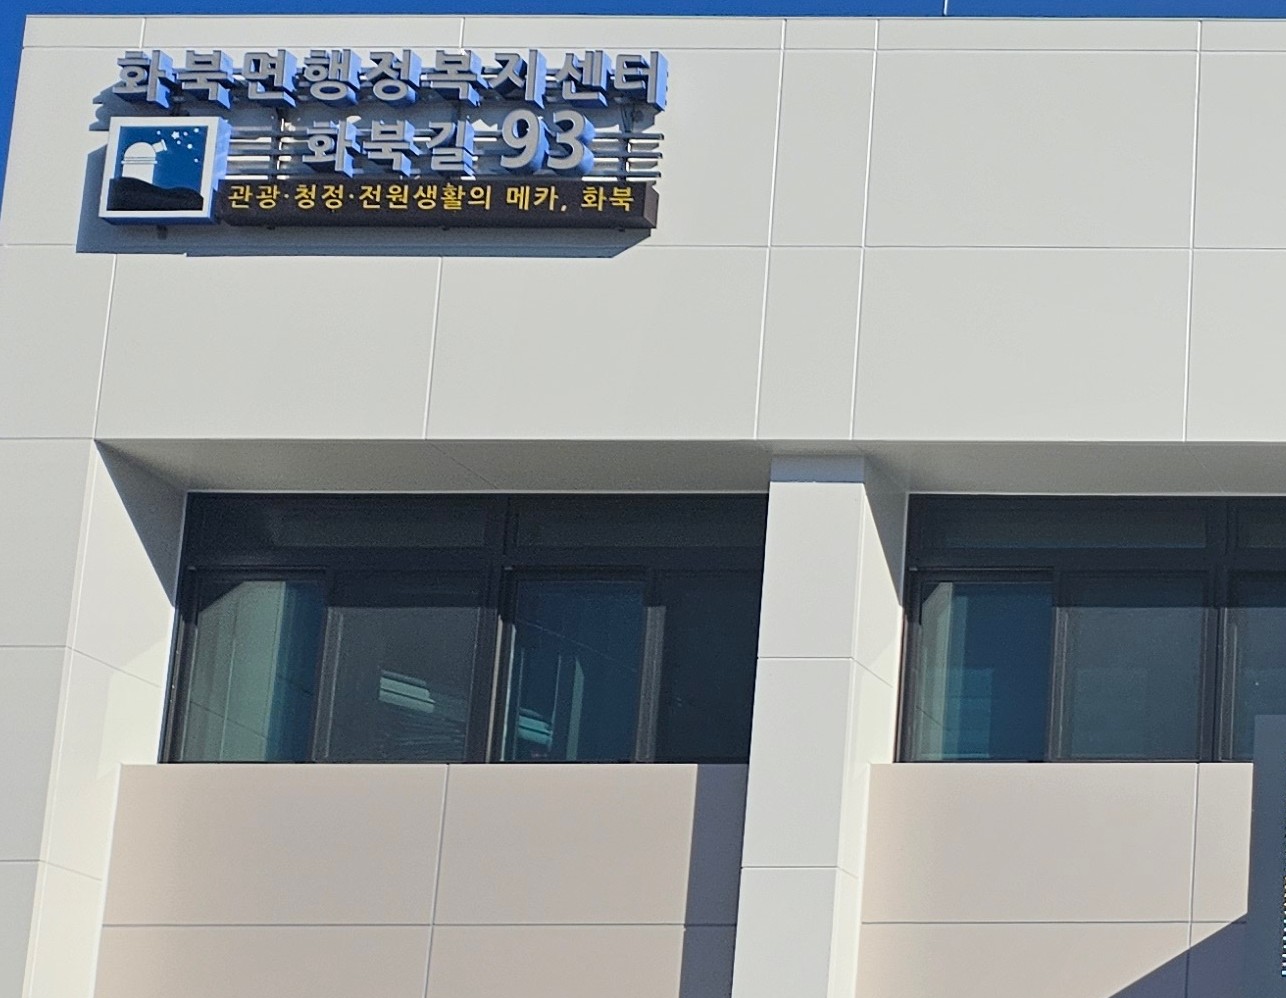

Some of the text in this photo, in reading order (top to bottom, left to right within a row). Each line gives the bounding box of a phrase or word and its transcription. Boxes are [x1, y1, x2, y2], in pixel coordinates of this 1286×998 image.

[115, 49, 665, 108] 화북면행정복지센터
[302, 109, 593, 175] 화북길 93
[506, 185, 567, 212] 메카,
[581, 184, 634, 212] 화북
